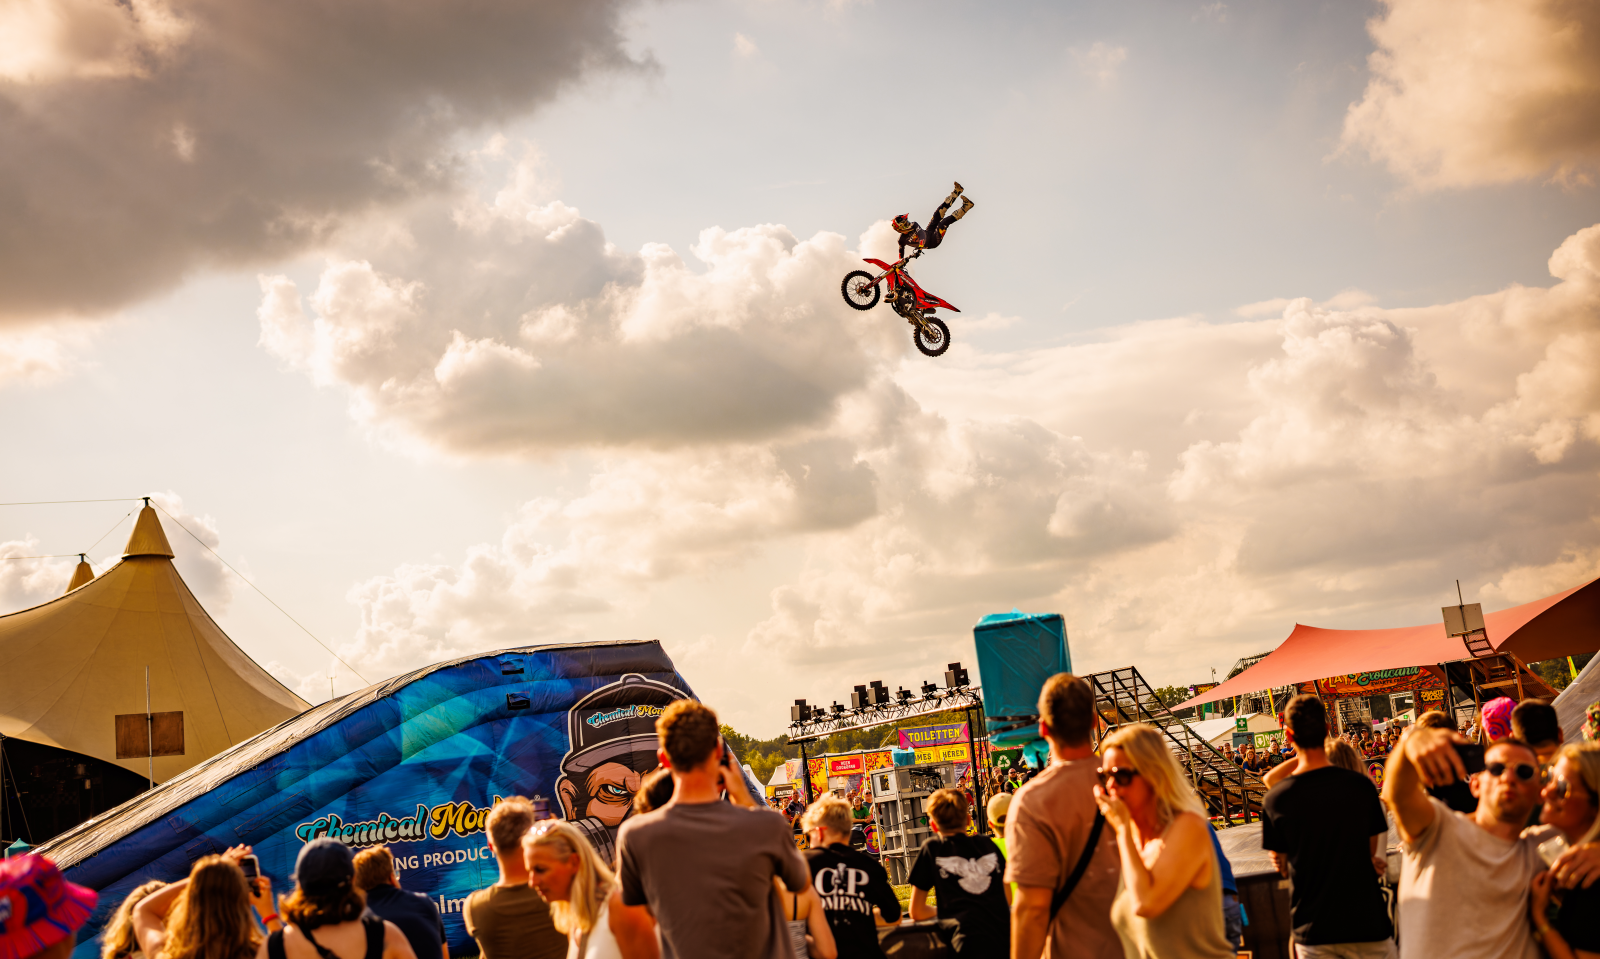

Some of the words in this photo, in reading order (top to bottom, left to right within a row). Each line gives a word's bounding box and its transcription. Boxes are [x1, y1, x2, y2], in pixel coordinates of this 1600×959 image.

[587, 704, 636, 727] Chemical
[907, 728, 961, 742] TOILETTEN
[942, 749, 965, 758] HEREN
[296, 803, 429, 848] Chemical
[393, 856, 419, 870] NG
